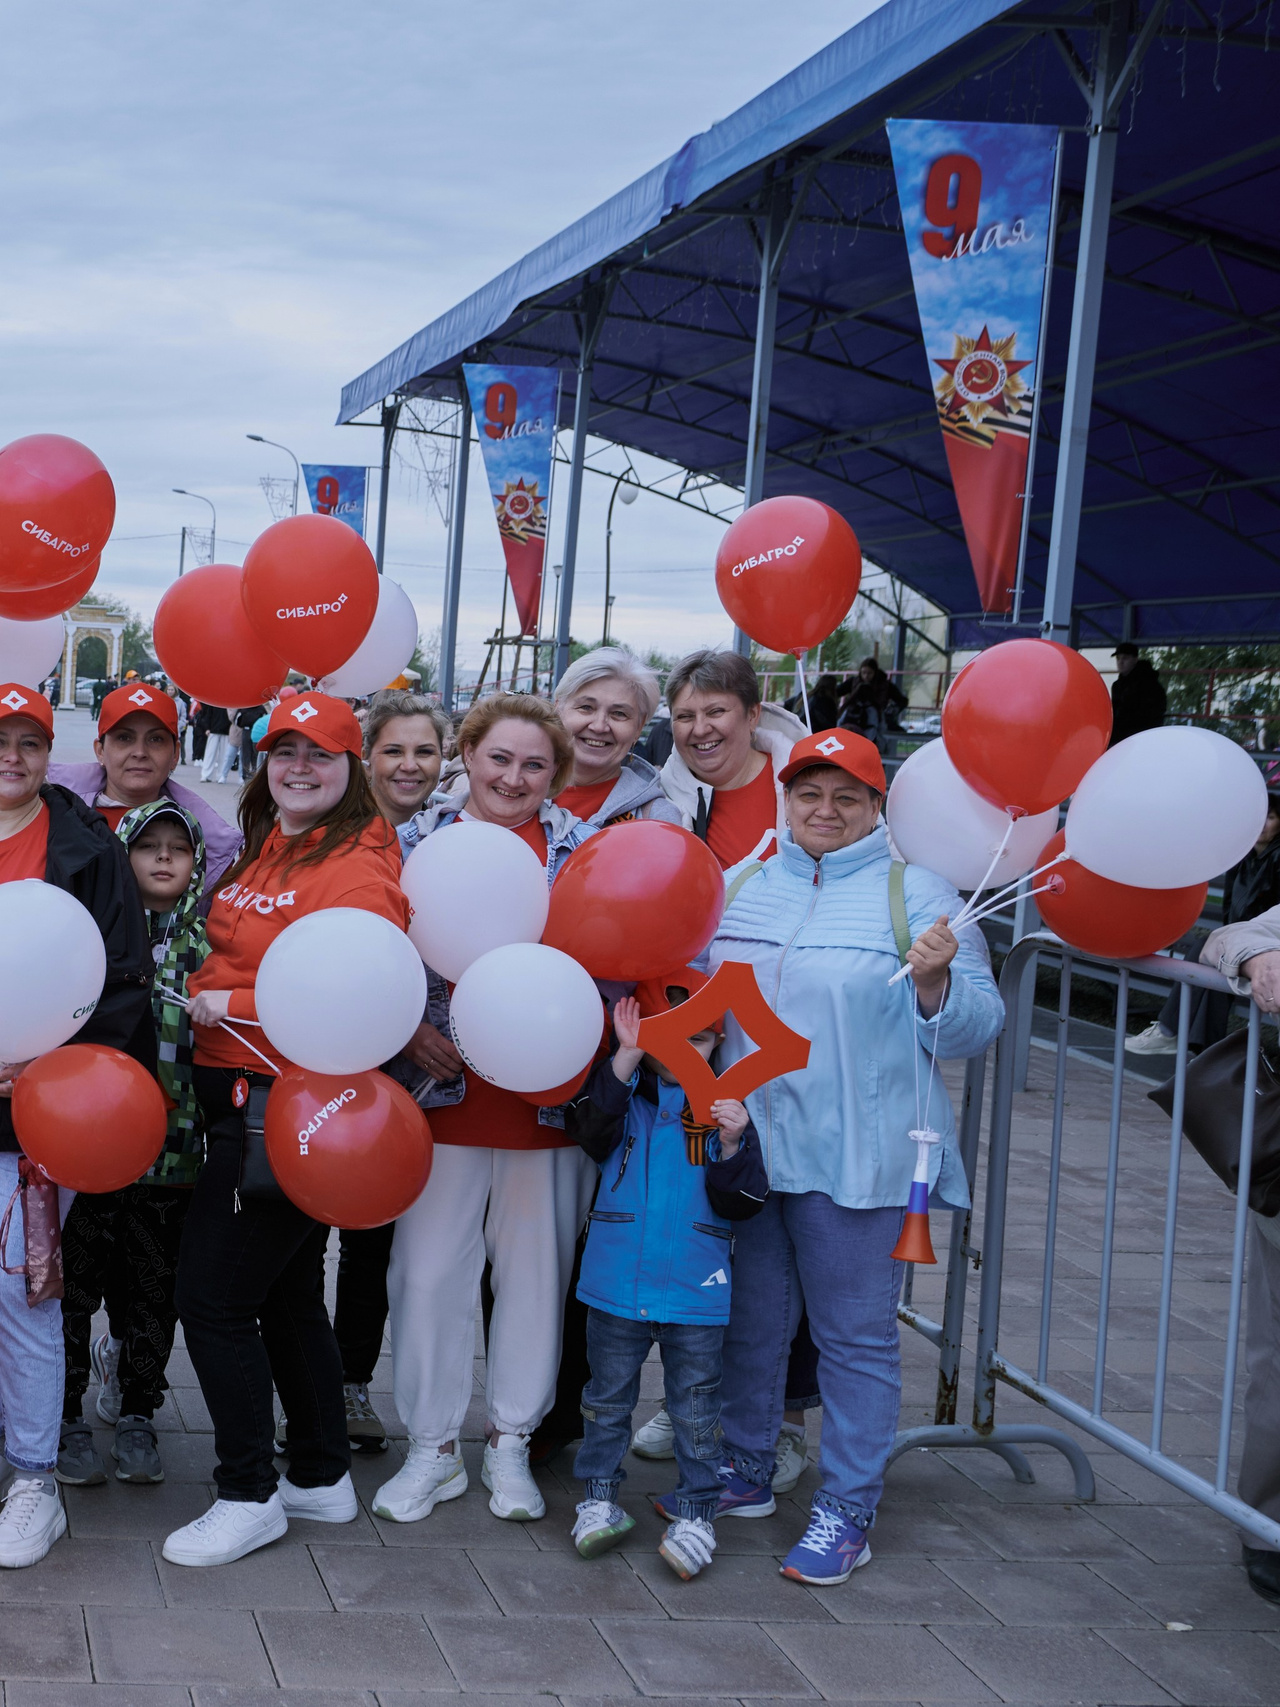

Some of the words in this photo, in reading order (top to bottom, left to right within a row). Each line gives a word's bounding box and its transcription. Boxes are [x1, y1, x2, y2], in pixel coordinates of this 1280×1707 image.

[922, 154, 982, 259] 9
[942, 218, 1035, 263] мая
[484, 382, 518, 440] 9
[496, 417, 548, 442] мая
[316, 476, 339, 514] 9
[21, 519, 81, 558] СИБАГРО
[731, 544, 797, 577] СИБАГРО
[276, 601, 342, 619] СИБАГРО
[298, 1088, 357, 1143] СИБАГРО
